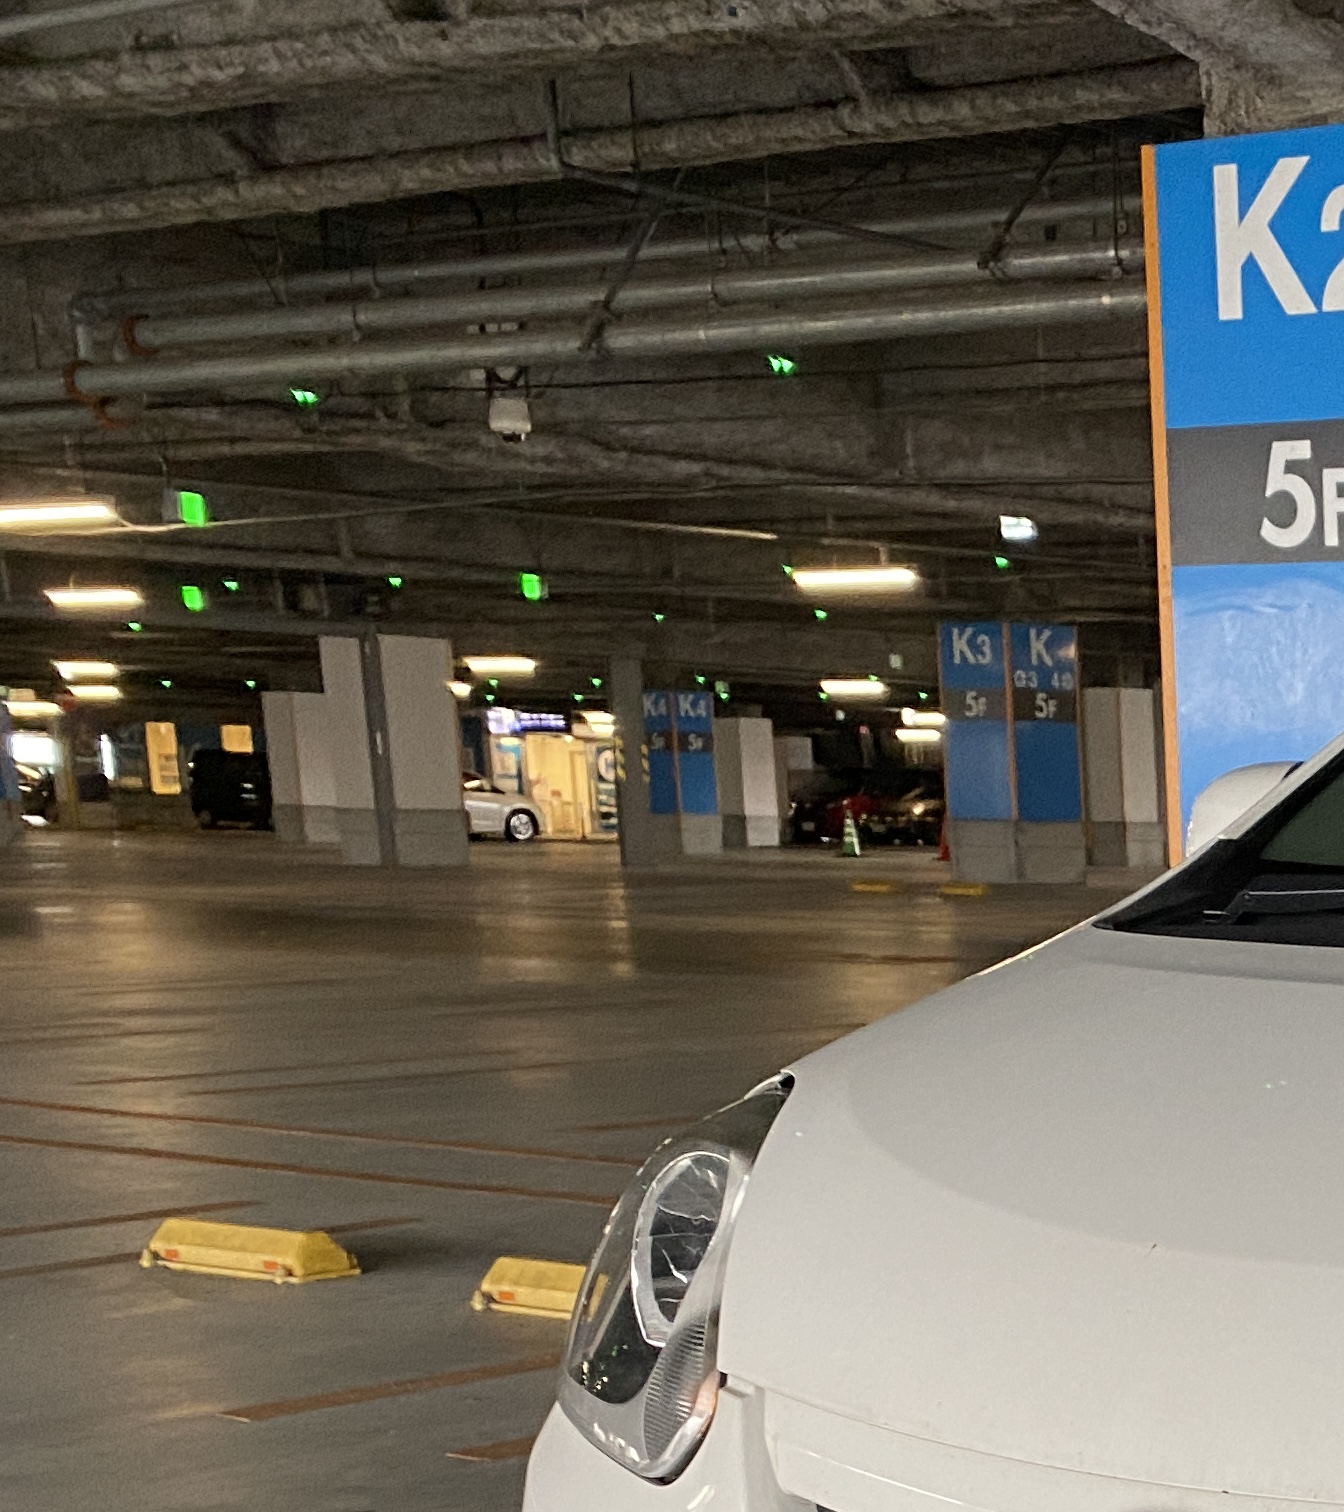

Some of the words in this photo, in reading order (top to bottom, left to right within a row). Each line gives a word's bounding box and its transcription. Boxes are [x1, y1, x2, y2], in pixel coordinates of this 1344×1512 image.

[951, 626, 993, 665] K3
[1028, 627, 1054, 668] K
[679, 693, 707, 718] K4
[964, 690, 987, 718] 5F
[1034, 692, 1058, 719] 5F
